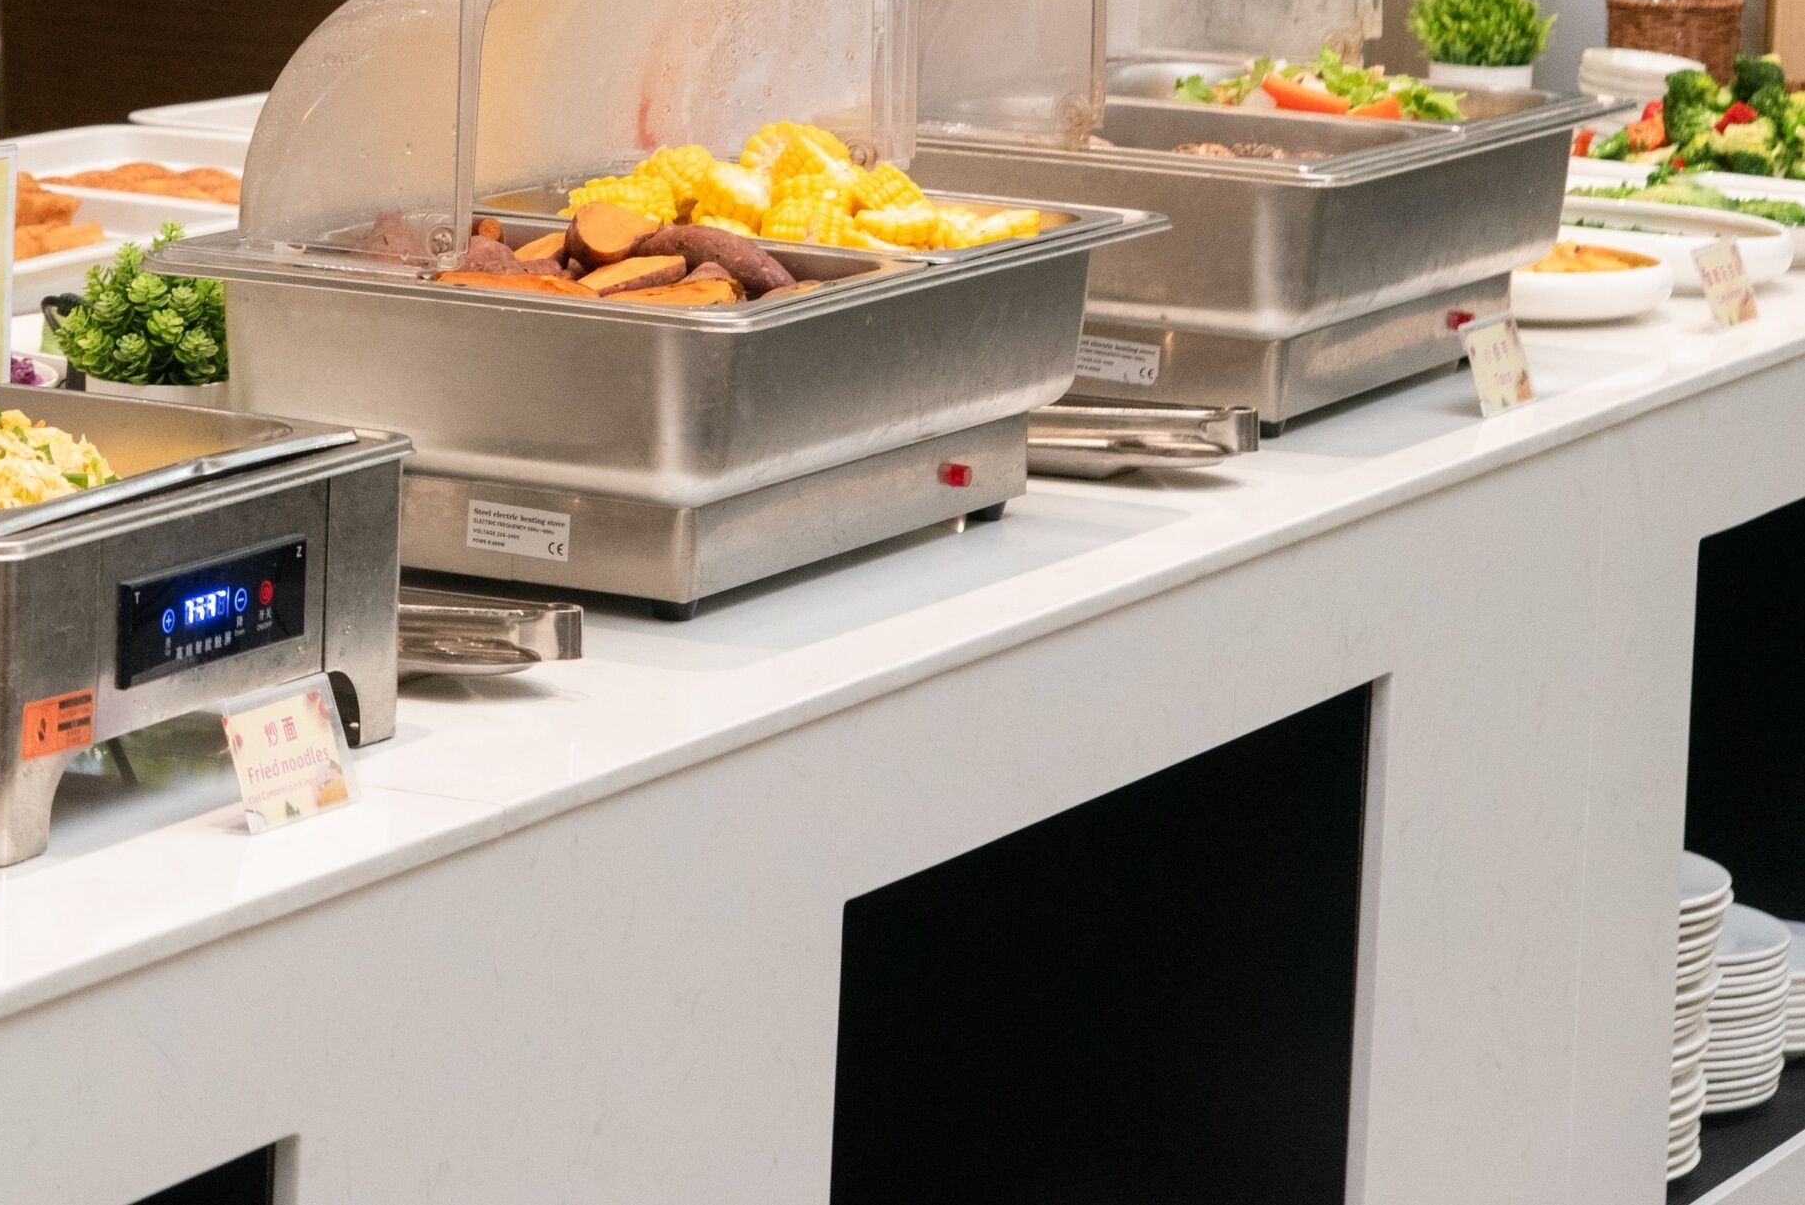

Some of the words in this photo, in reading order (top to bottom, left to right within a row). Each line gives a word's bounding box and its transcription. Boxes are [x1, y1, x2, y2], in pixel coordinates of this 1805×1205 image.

[493, 510, 519, 521] electric
[520, 514, 545, 526] heating
[295, 545, 302, 559] Z
[263, 716, 298, 748] 炒面
[246, 757, 281, 785] Fried
[281, 747, 330, 774] noodles
